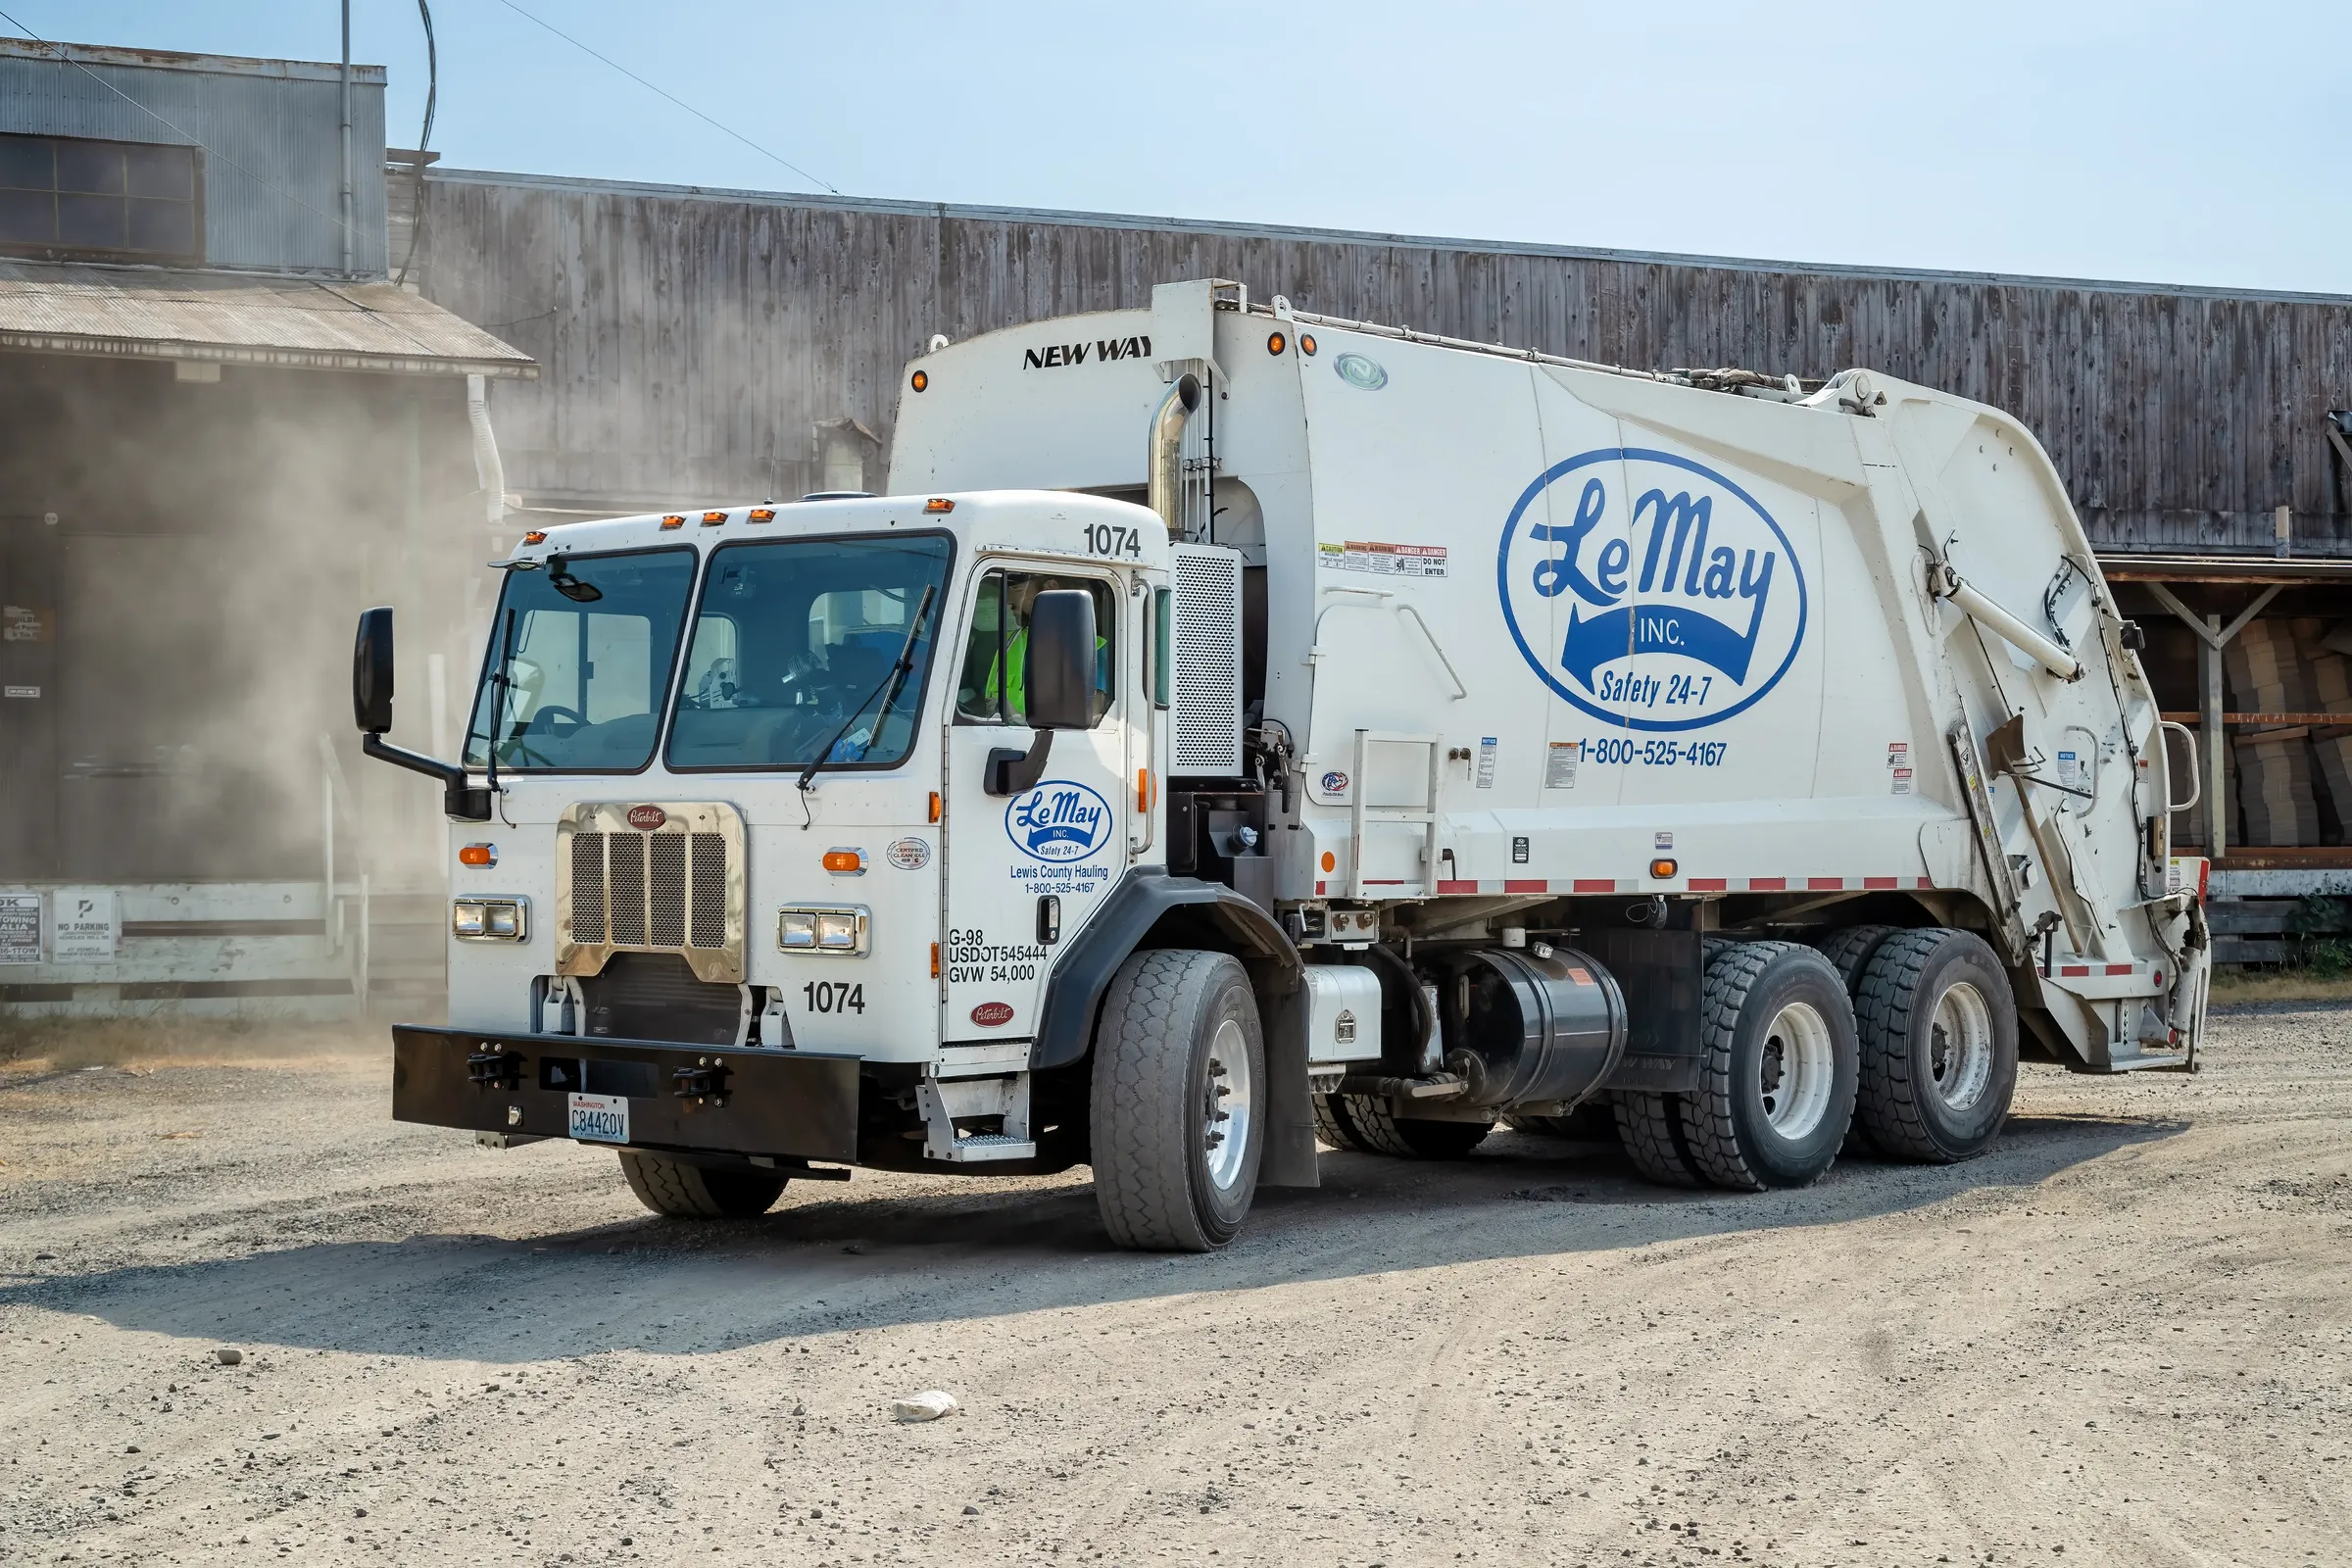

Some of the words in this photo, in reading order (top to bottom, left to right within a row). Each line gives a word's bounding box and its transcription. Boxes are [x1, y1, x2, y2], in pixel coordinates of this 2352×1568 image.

[1023, 342, 1092, 370] NEW
[1083, 523, 1142, 558] 1074
[1326, 545, 1344, 554] CAUTION
[1375, 545, 1395, 554] WARNING
[1402, 546, 1421, 556] DANGER
[1427, 548, 1446, 557] DANGER
[1530, 477, 1776, 639] LeMay
[1640, 617, 1686, 646] INC.
[1599, 670, 1661, 709] Safety
[1666, 673, 1713, 707] 24-7
[1579, 737, 1728, 766] 1-800-525-4167
[630, 810, 662, 824] Peterbilt
[1015, 790, 1102, 834] LeMay
[1053, 829, 1069, 838] INC.
[1040, 846, 1061, 857] Safety
[1062, 845, 1079, 856] 24-7
[1010, 865, 1038, 879] Lewis
[1040, 865, 1072, 882] County
[1074, 864, 1108, 881] Hauling
[1025, 882, 1095, 894] 1-800-525-4167
[949, 929, 984, 946] G-98
[949, 966, 985, 983] GVW
[990, 964, 1035, 984] 54,000
[804, 981, 865, 1014] 1074
[975, 1006, 1011, 1021] Peterbilt
[571, 1109, 624, 1136] C84420V
